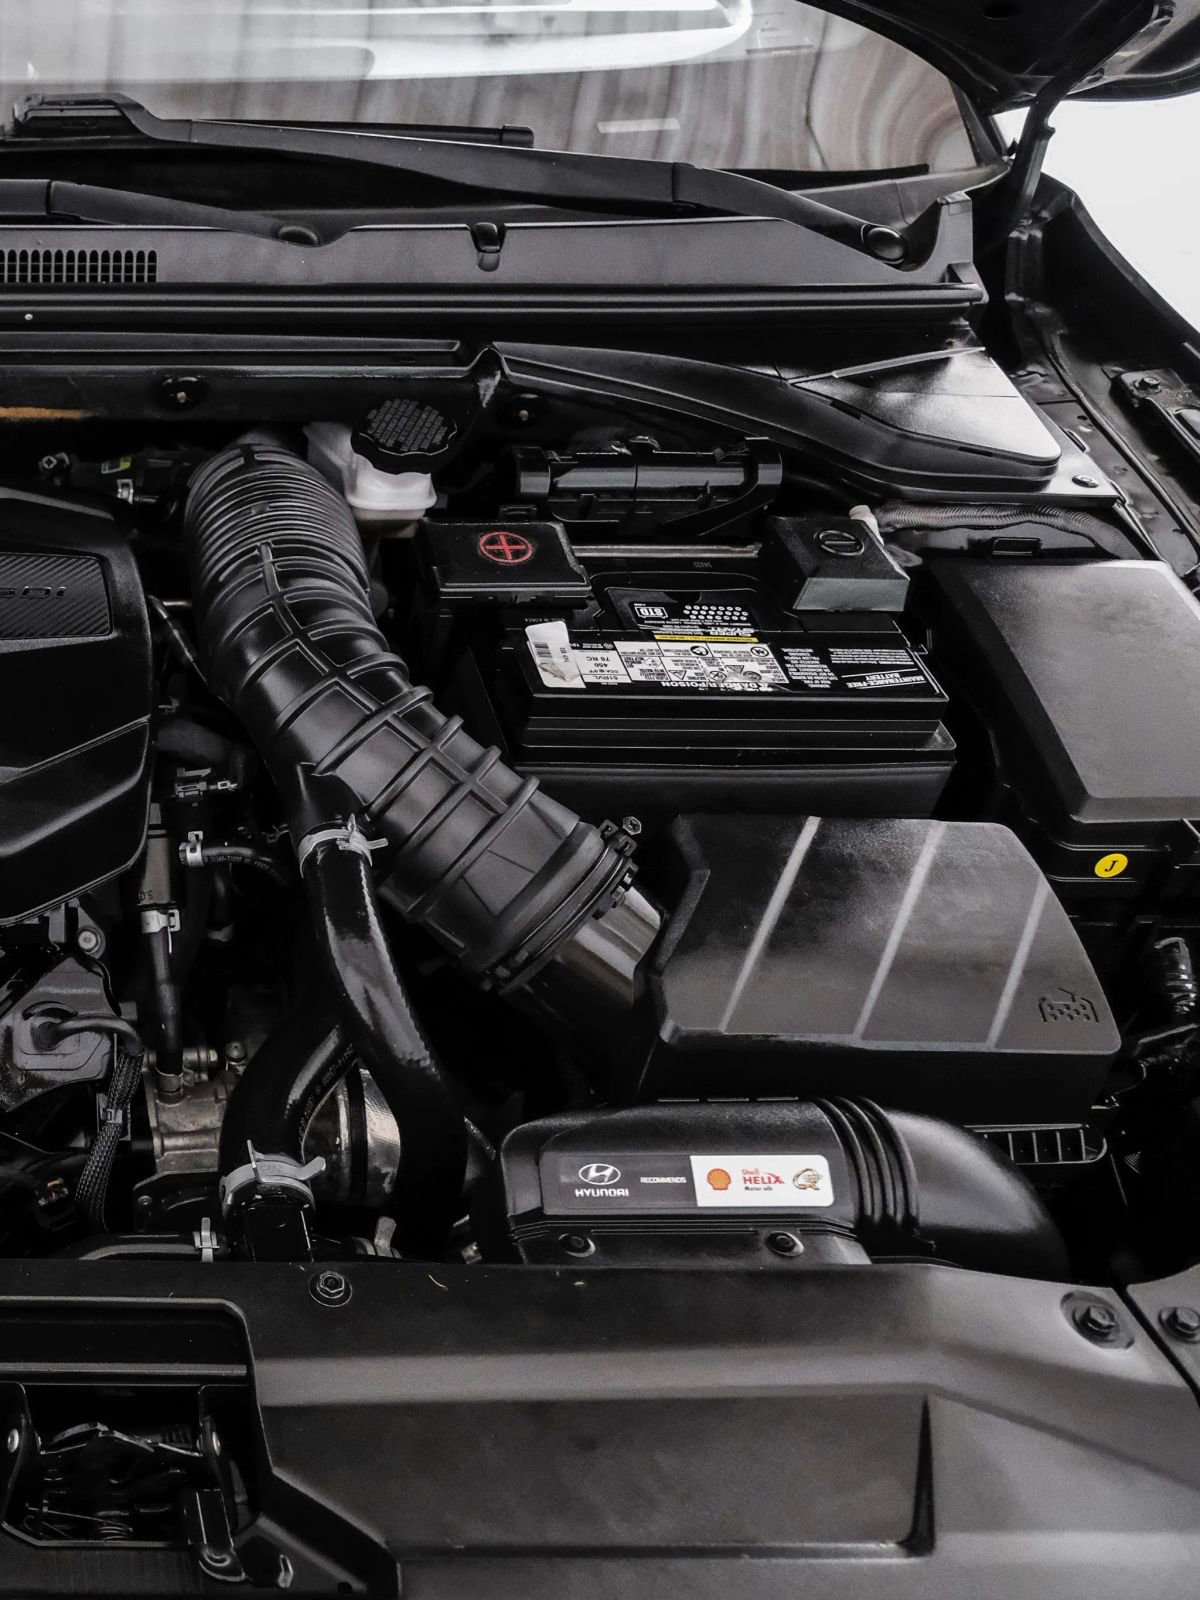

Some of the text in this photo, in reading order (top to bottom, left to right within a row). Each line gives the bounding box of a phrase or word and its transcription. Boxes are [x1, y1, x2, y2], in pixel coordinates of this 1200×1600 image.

[846, 675, 925, 688] MAINTENANCE-FREE
[865, 673, 900, 681] BATTERY
[1104, 860, 1119, 872] J
[742, 1168, 759, 1176] Shell
[640, 1176, 785, 1185] RECOMMENDS HELIX
[574, 1188, 629, 1198] HYUNDAI
